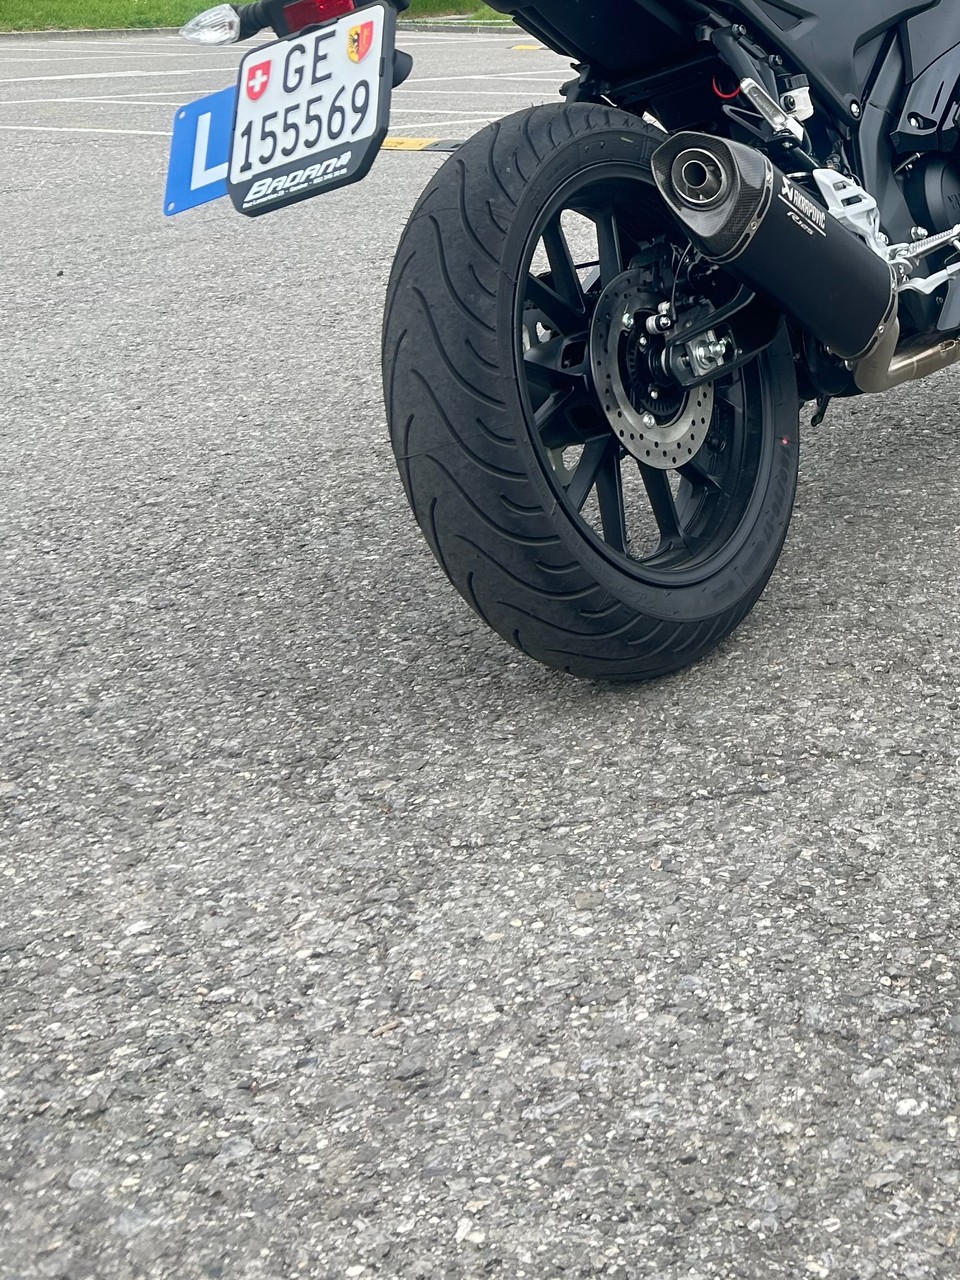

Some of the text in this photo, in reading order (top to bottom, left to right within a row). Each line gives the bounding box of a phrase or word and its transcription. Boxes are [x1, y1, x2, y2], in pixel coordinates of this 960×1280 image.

[282, 29, 336, 94] GE
[190, 111, 229, 191] L
[239, 79, 370, 173] 155569
